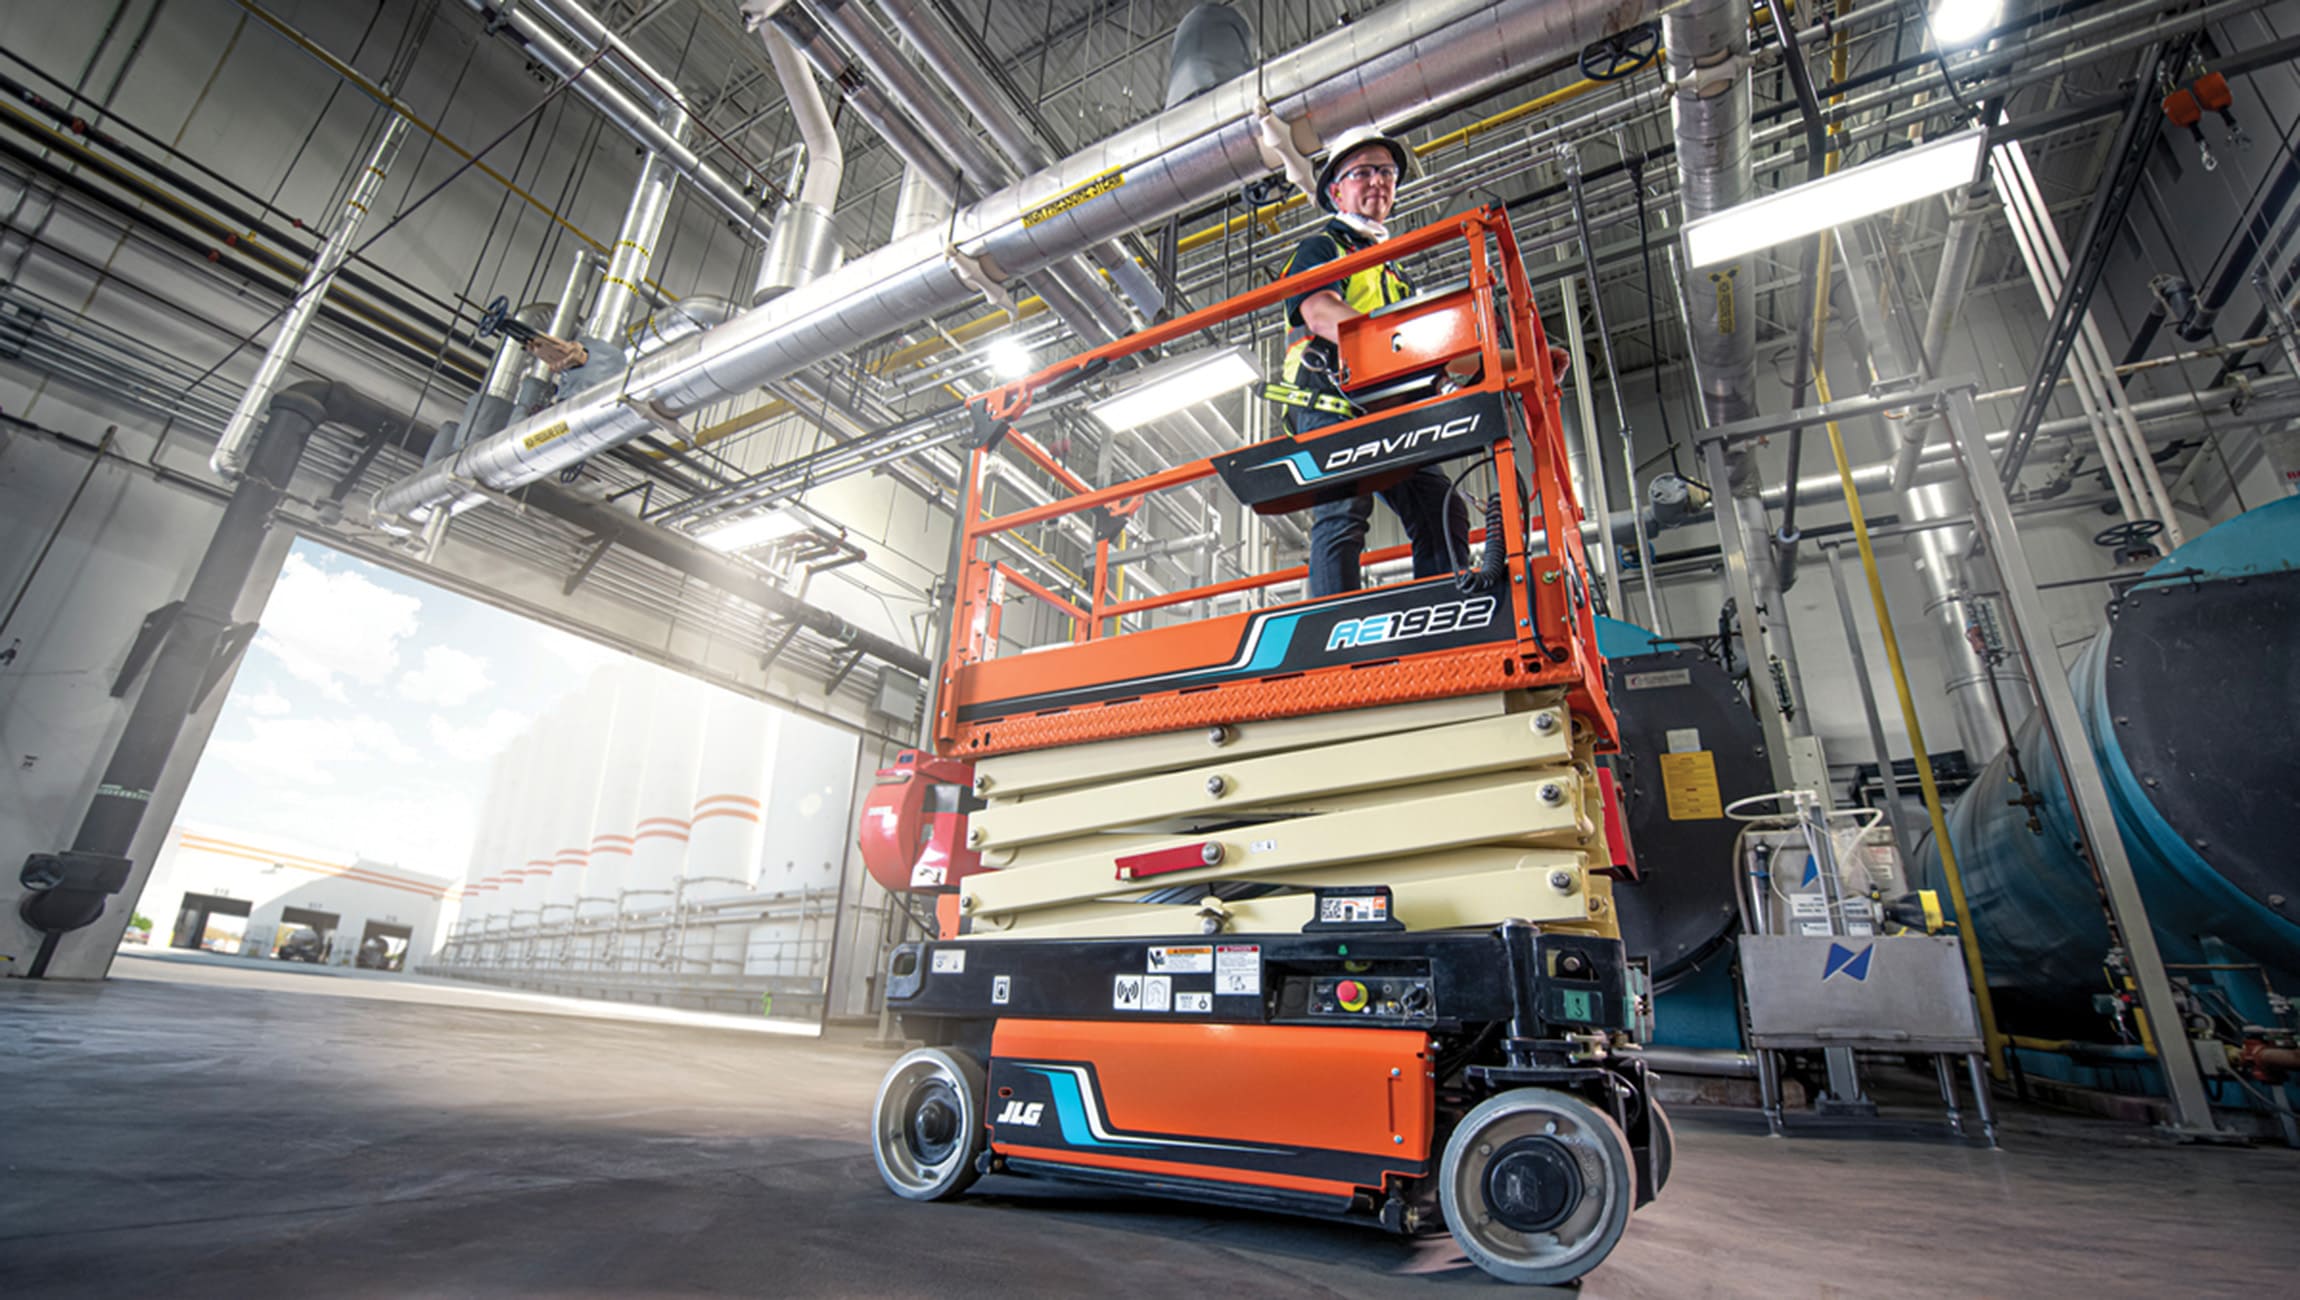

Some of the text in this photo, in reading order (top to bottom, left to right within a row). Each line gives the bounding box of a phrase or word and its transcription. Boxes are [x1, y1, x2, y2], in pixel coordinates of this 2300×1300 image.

[1325, 414, 1480, 470] DAVINCI
[1325, 596, 1496, 651] AE1932
[997, 1101, 1044, 1126] JLG
